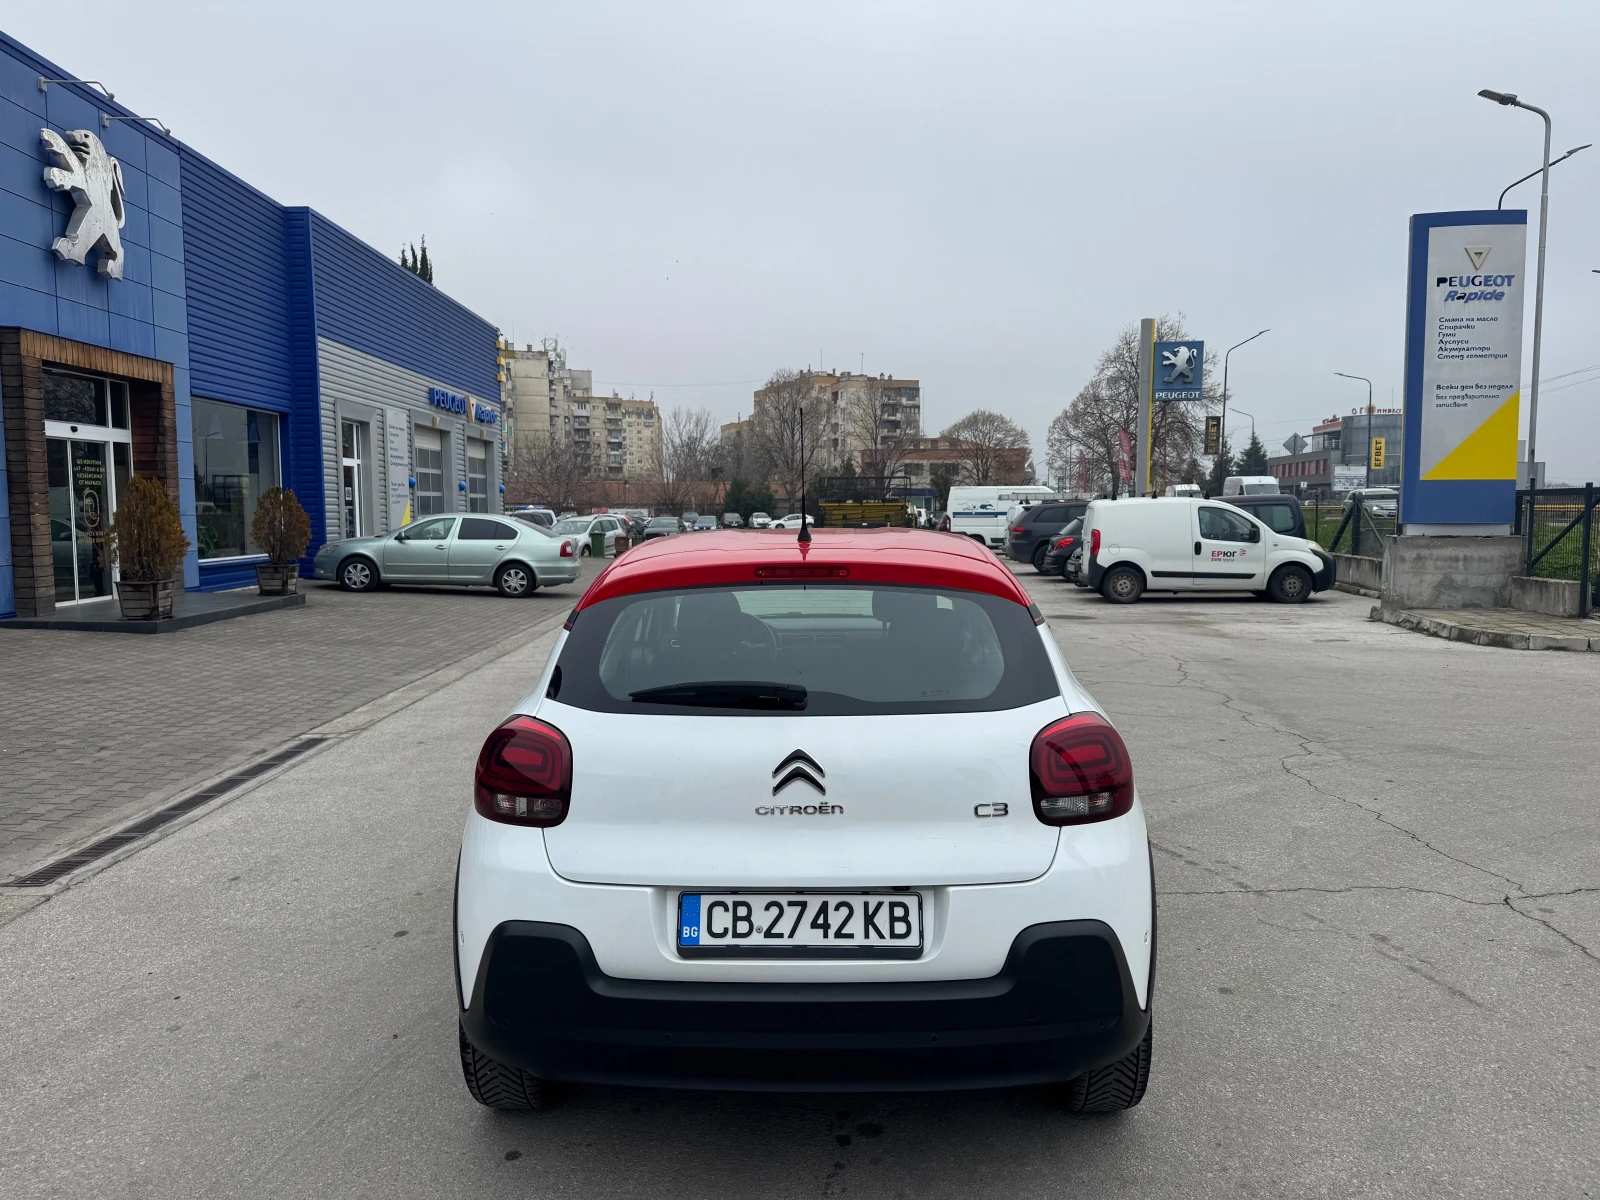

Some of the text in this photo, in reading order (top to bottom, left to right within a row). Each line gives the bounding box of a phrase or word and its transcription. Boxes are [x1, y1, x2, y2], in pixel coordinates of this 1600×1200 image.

[1436, 275, 1515, 287] PEUGEOT
[1444, 290, 1505, 304] Rapide
[1438, 323, 1475, 331] Спирачки
[1155, 391, 1201, 399] PEUGEOT
[1448, 393, 1500, 401] предварително
[1374, 439, 1382, 467] EFBET
[755, 802, 844, 816] CITROËN
[974, 802, 1009, 818] C3
[682, 926, 698, 938] BG
